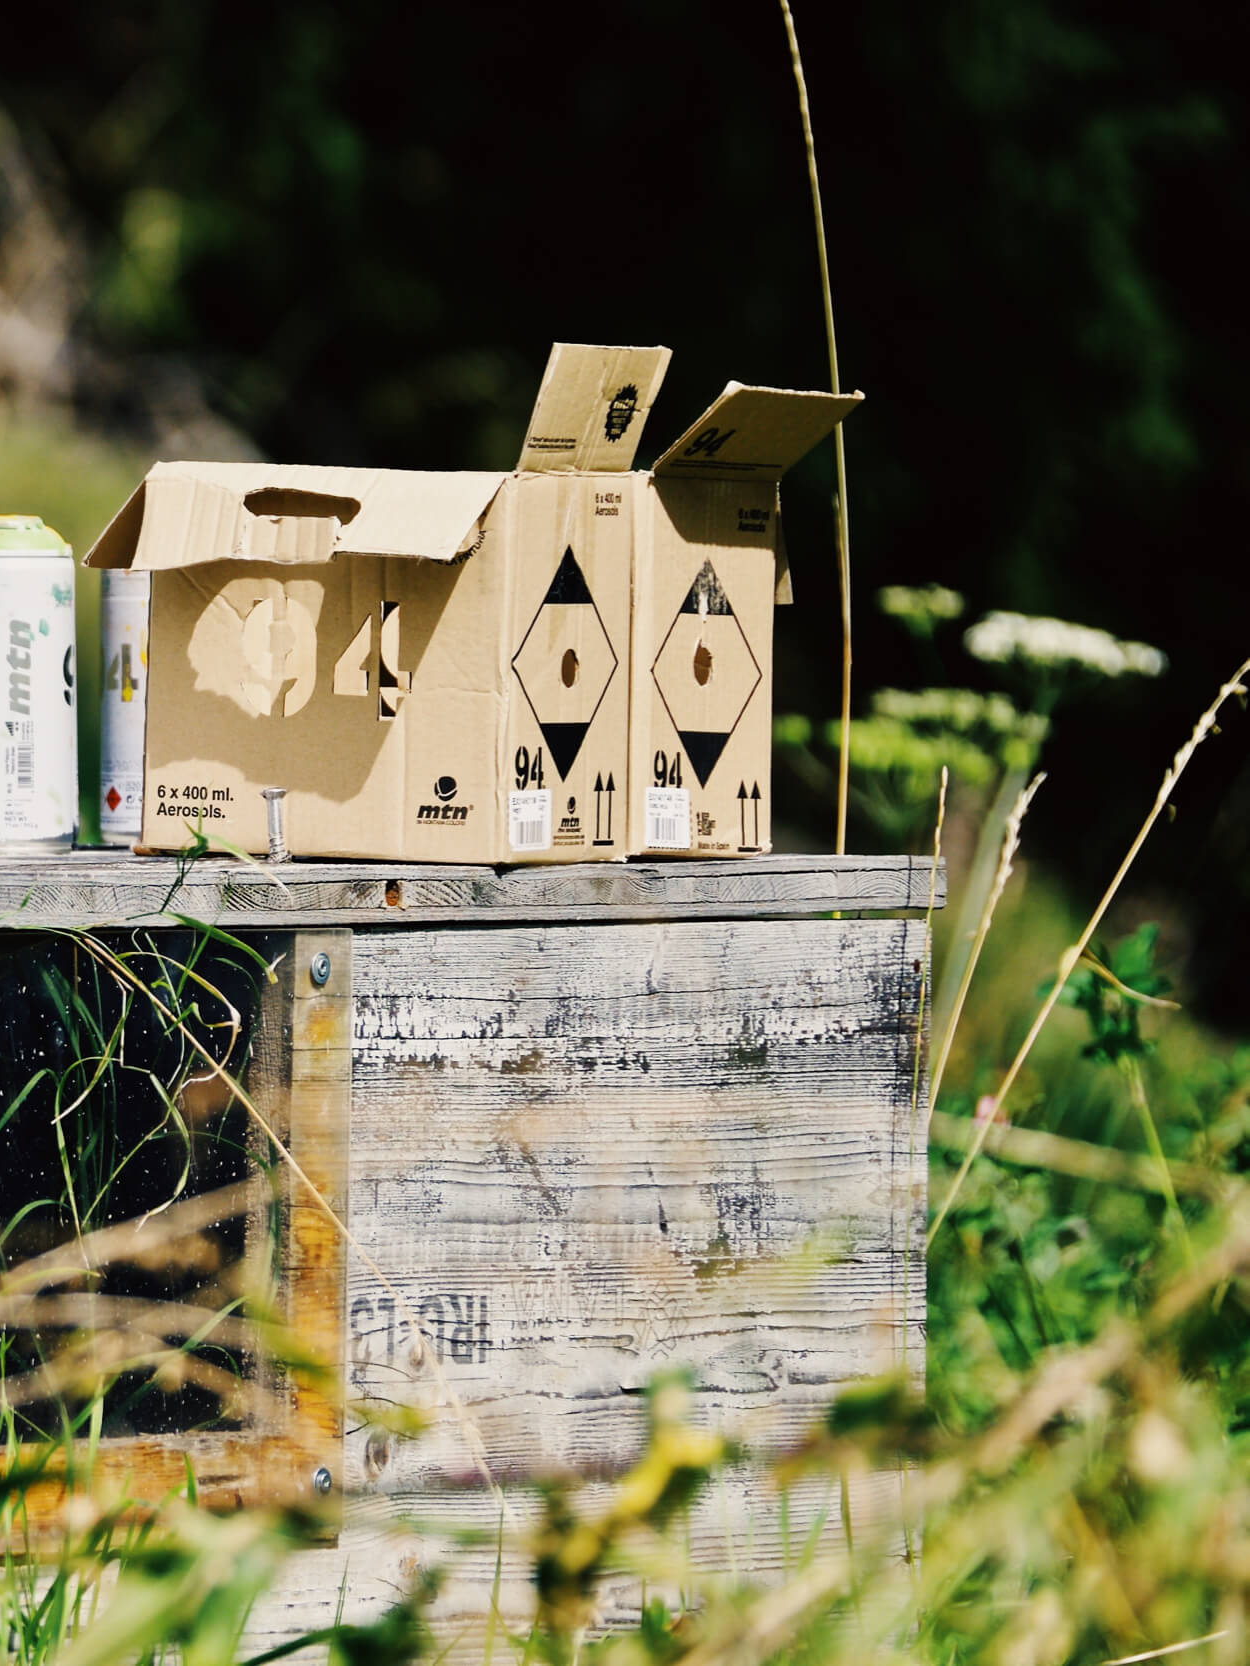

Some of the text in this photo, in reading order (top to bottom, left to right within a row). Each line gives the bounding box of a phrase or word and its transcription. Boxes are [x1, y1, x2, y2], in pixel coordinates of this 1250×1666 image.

[5, 619, 33, 716] mtn
[514, 746, 545, 791] 94
[652, 750, 683, 788] 94
[157, 785, 166, 799] 6
[169, 789, 179, 799] x
[181, 787, 208, 801] 400
[212, 788, 234, 802] ml.
[156, 802, 226, 819] Aerosols.
[417, 804, 469, 820] mtn
[560, 817, 580, 828] mtn
